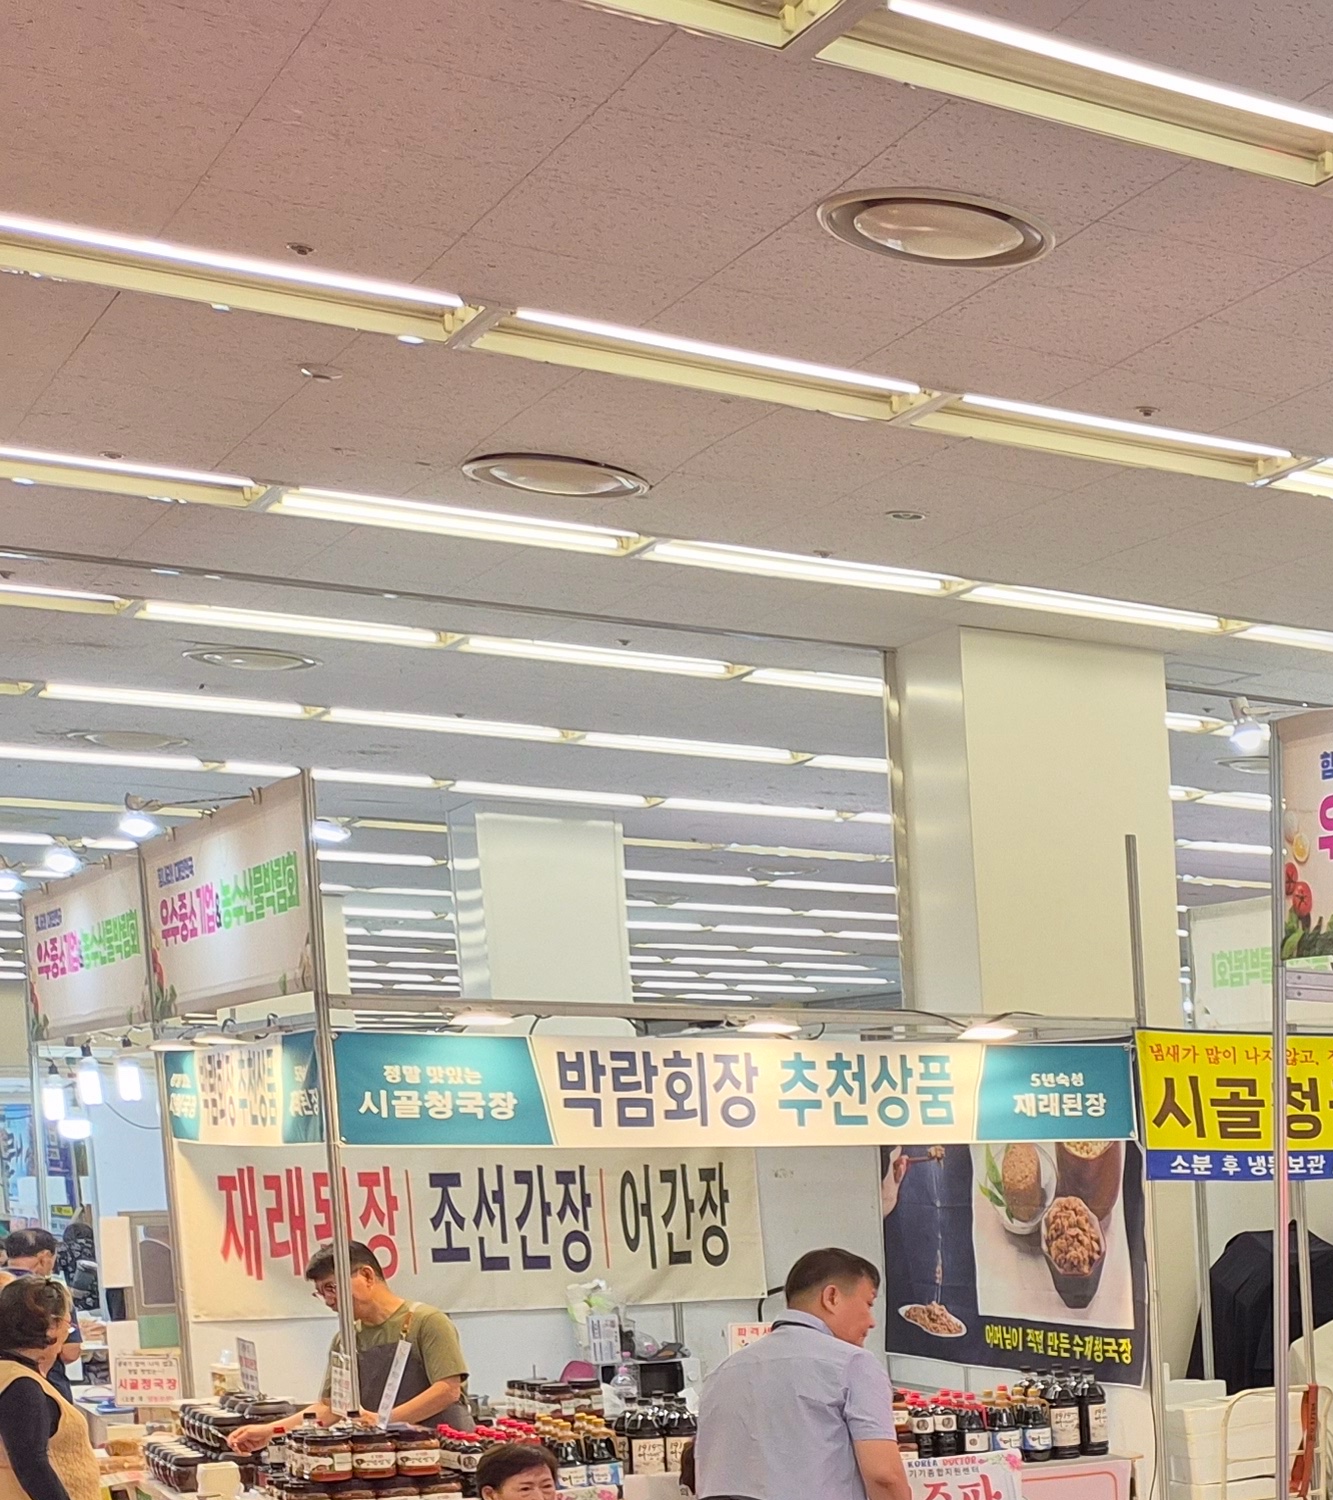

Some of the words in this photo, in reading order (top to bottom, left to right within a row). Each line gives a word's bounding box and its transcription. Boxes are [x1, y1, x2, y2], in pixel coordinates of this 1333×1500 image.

[1150, 1044, 1199, 1065] 냄새가
[1205, 1046, 1238, 1065] 많이
[383, 1065, 421, 1084] 정말
[427, 1065, 483, 1085] 맛있는
[1030, 1072, 1085, 1088] 5년숙성
[556, 1049, 759, 1128] 박람회장
[778, 1053, 955, 1127] 추천상품
[358, 1089, 518, 1120] 시골청국장
[1013, 1092, 1106, 1118] 재래된장
[1170, 1154, 1212, 1175] 소분
[1221, 1154, 1242, 1175] 후
[428, 1164, 592, 1273] 조선간장
[620, 1162, 730, 1269] 어간장
[985, 1324, 1022, 1351] 어머님이
[1047, 1332, 1070, 1357] 만든
[908, 1459, 938, 1468] KOREA
[942, 1456, 977, 1466] DOCTOR
